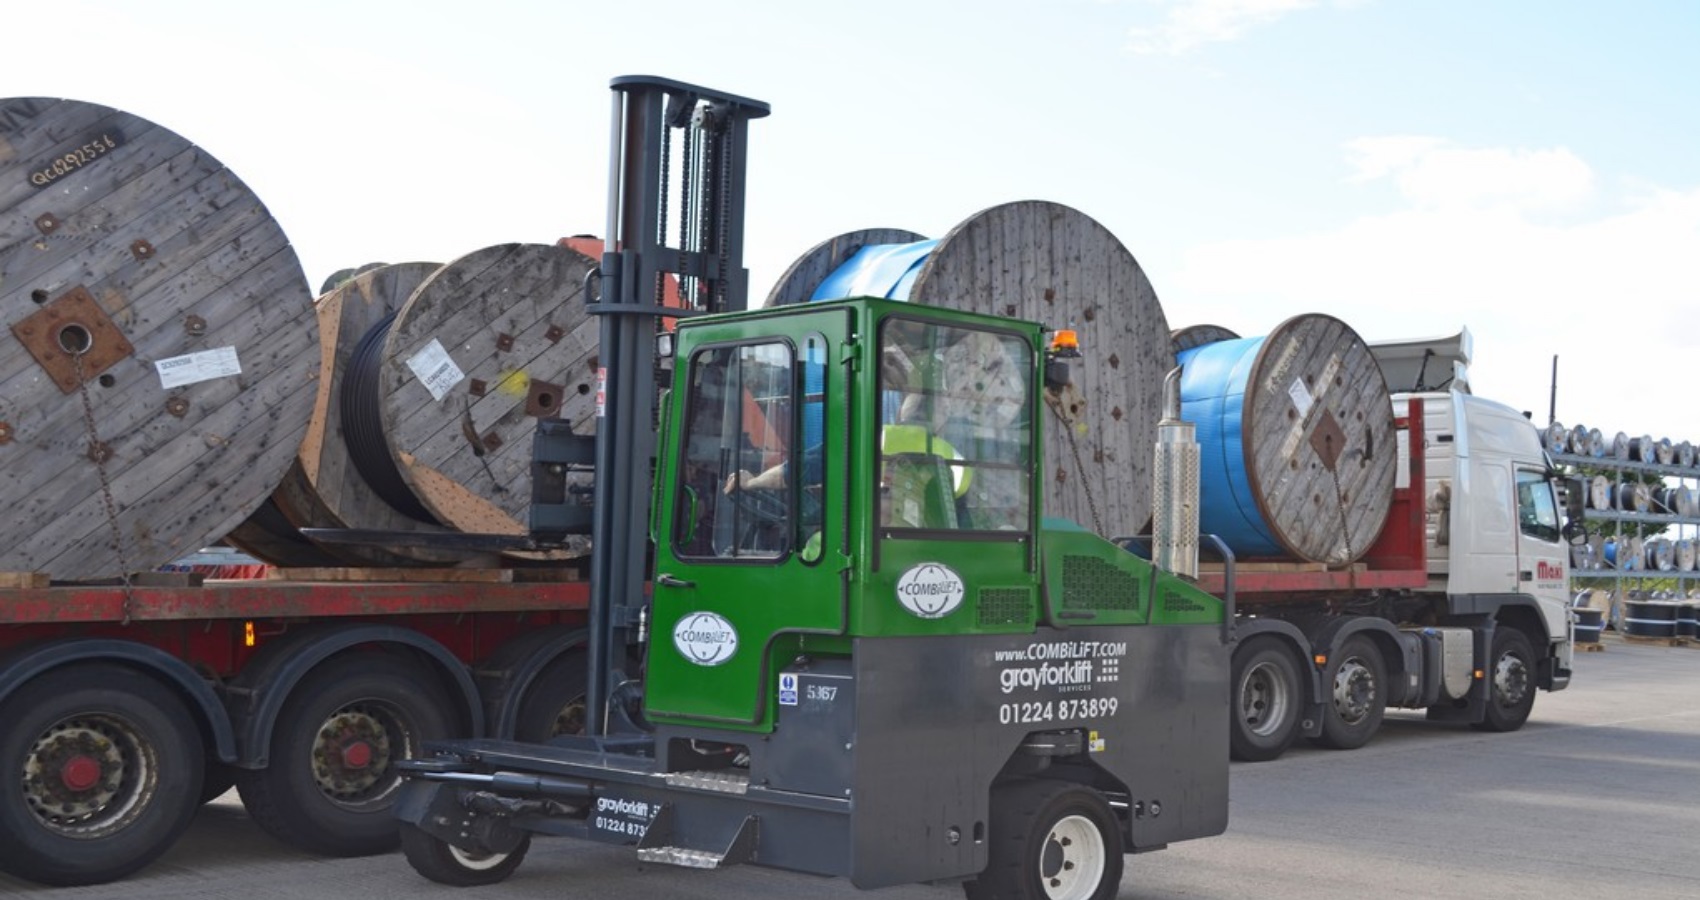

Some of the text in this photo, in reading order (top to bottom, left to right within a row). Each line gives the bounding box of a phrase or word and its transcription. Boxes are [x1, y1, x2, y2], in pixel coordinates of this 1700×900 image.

[1000, 660, 1092, 693] grayforklift
[1000, 697, 1118, 724] 01224 873899
[595, 816, 625, 833] 01224
[627, 822, 648, 837] 873
